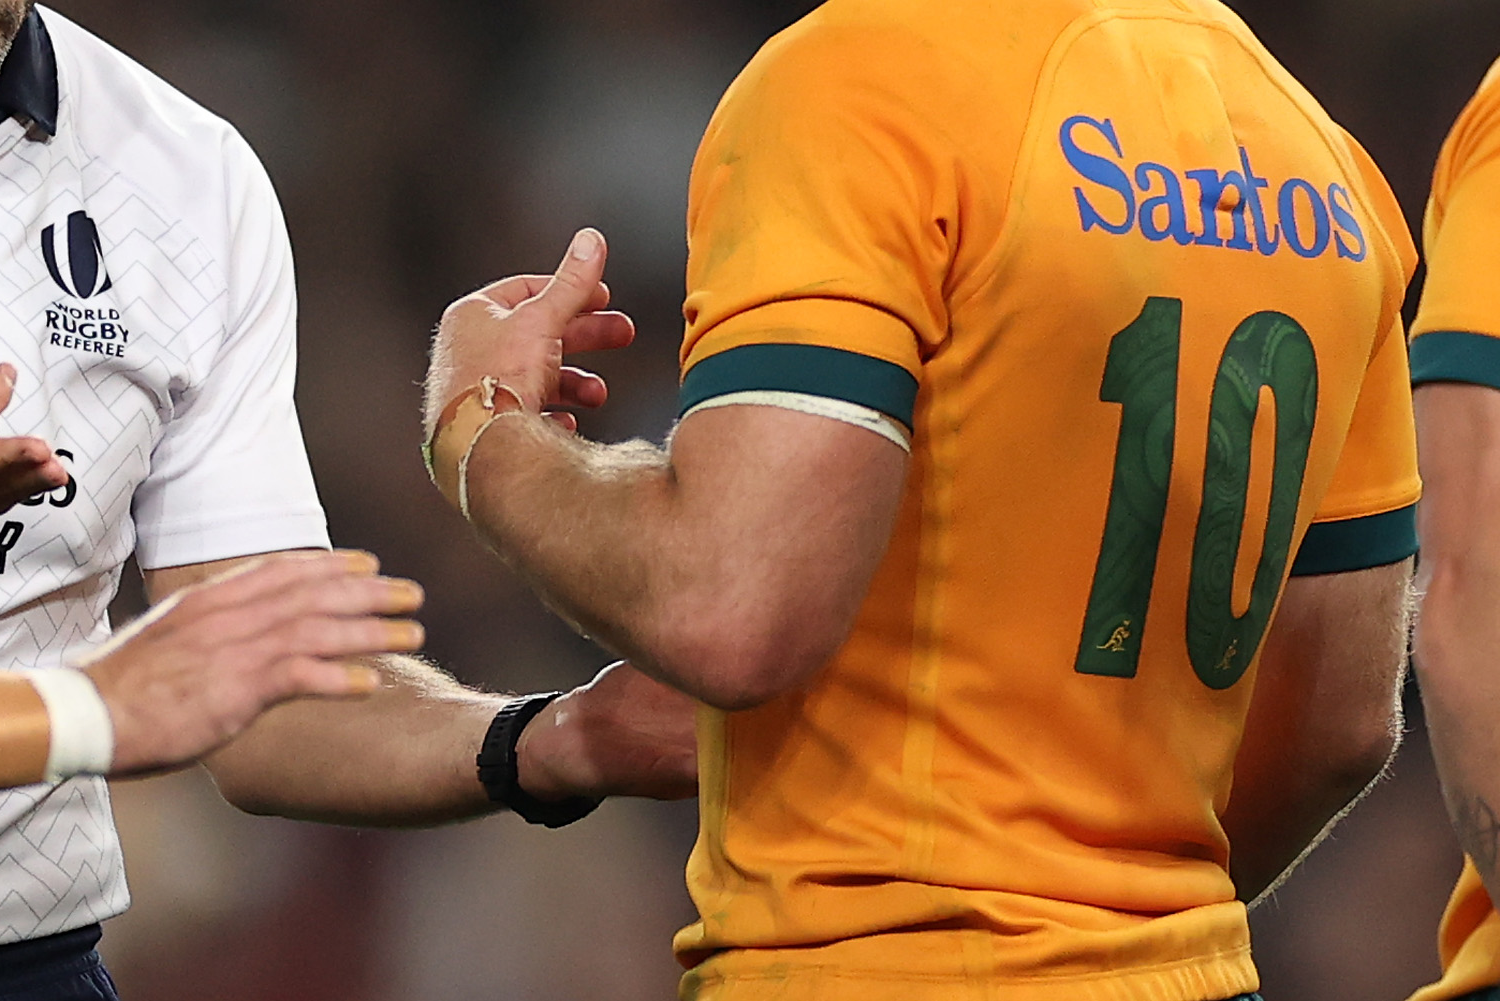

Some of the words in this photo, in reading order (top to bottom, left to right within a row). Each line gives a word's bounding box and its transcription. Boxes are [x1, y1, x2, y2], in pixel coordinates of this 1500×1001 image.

[1059, 115, 1367, 263] Santos
[45, 310, 129, 343] RUGBY
[52, 301, 120, 320] WORLD
[50, 332, 125, 358] REFEREE
[1073, 296, 1319, 690] 10
